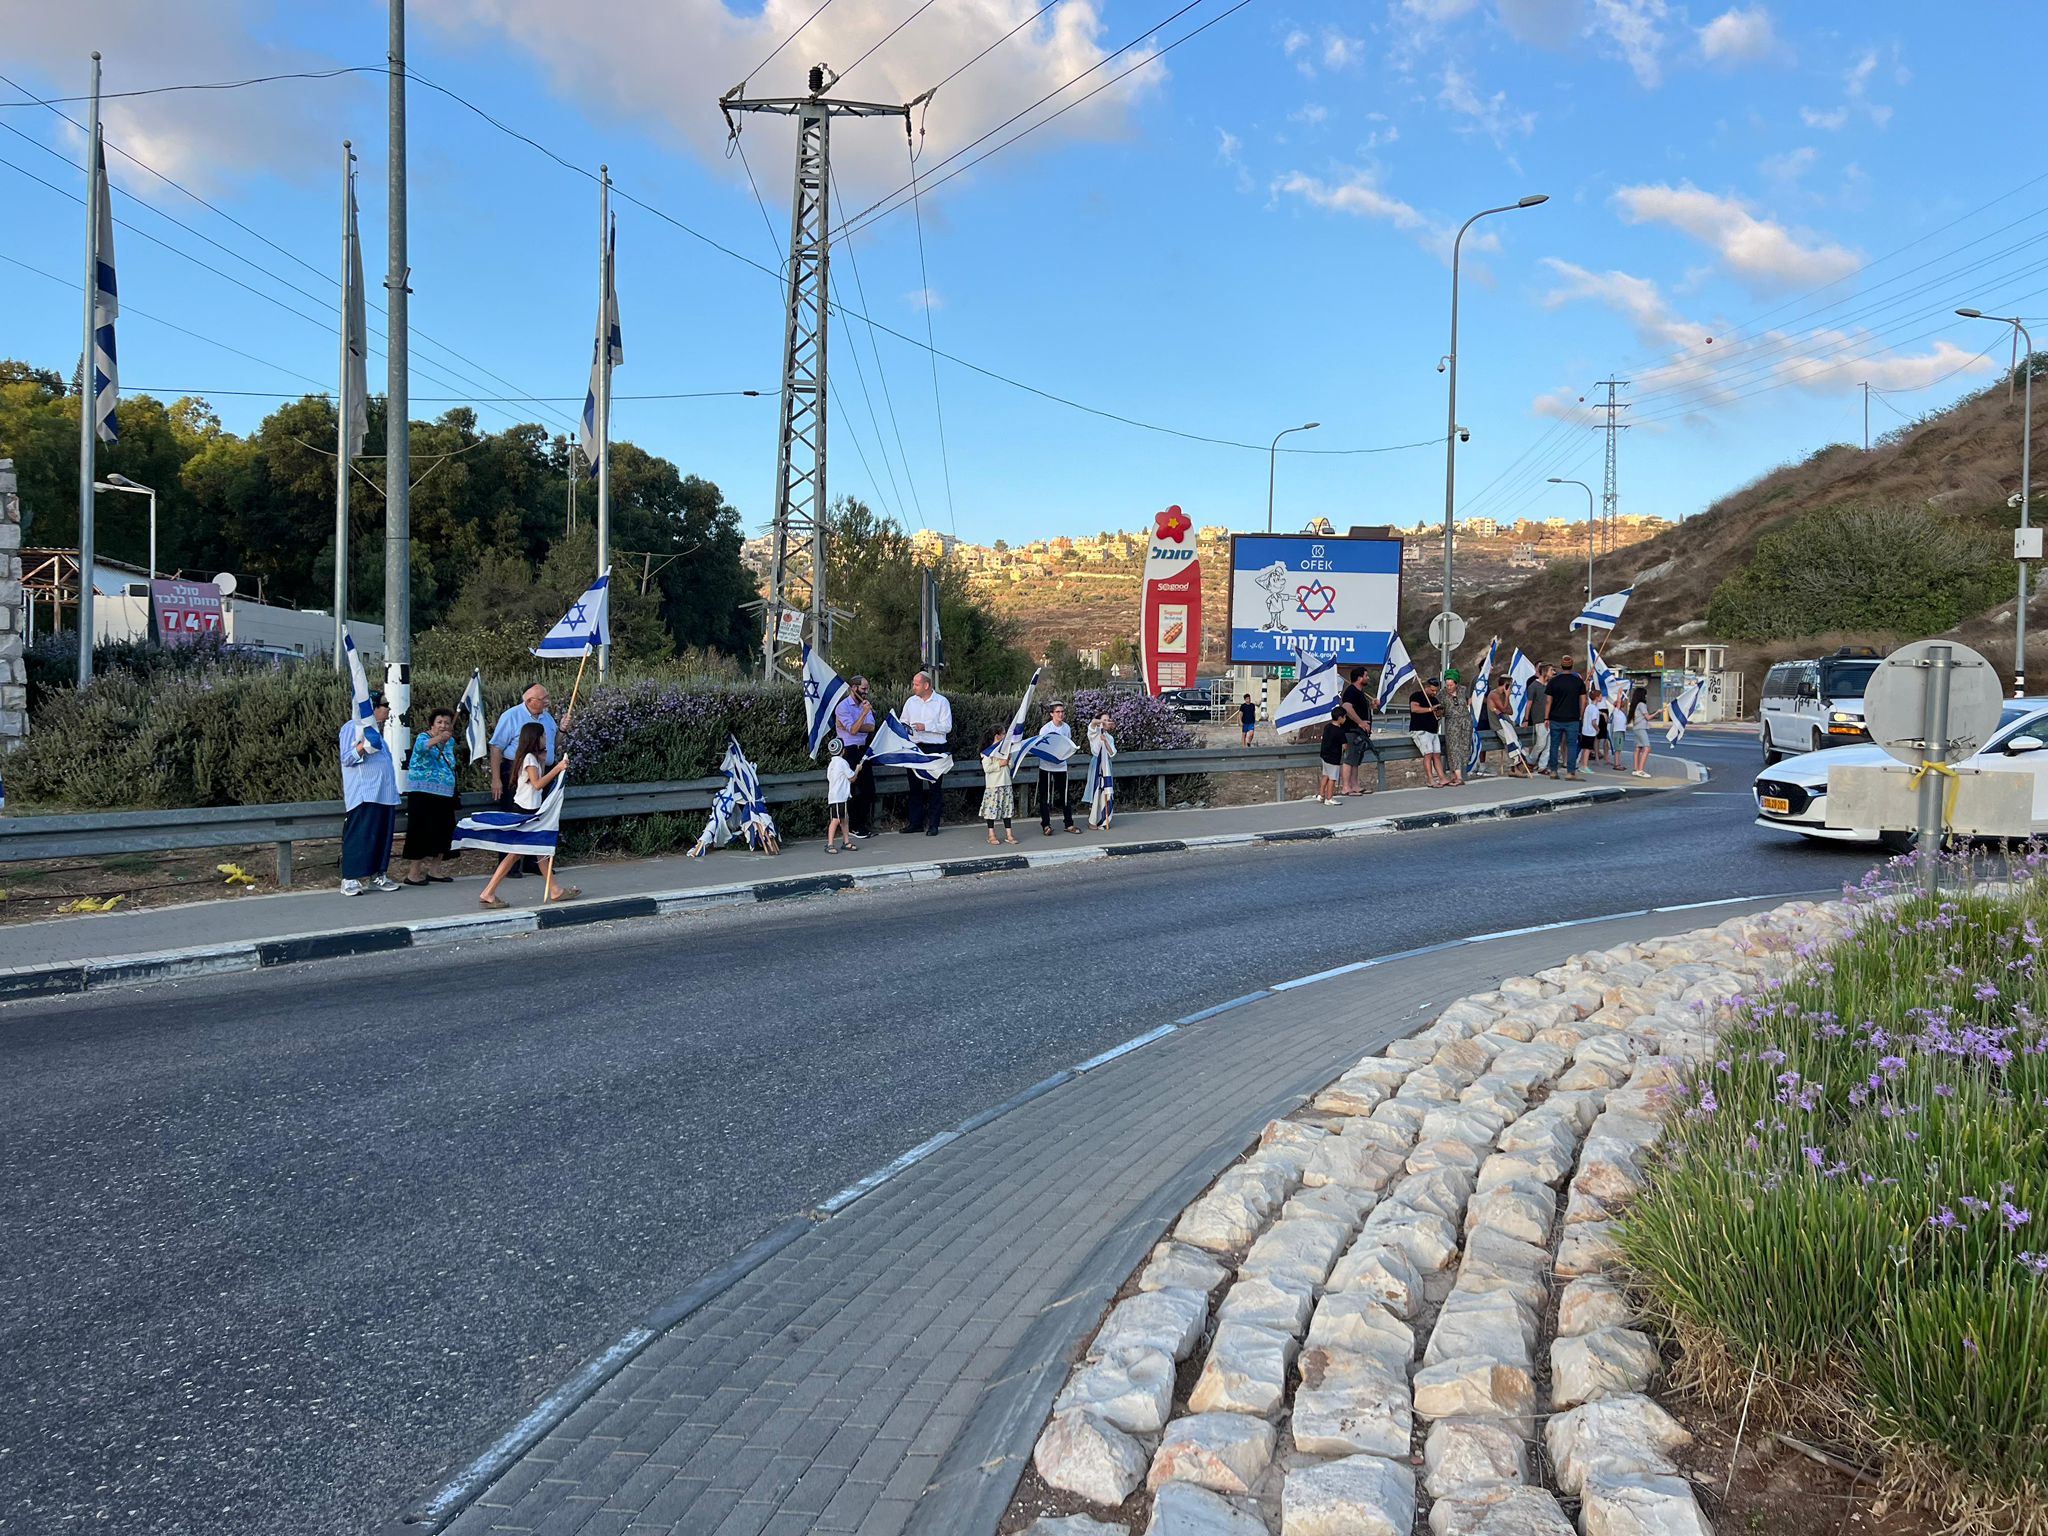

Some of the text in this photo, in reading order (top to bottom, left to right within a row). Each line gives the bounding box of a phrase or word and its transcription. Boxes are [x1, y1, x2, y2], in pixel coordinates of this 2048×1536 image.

[1151, 546, 1194, 560] סונול
[1300, 560, 1333, 570] OFEK
[173, 584, 199, 596] סולר
[155, 593, 219, 607] מזומן בלבד
[164, 611, 219, 631] 747
[1273, 633, 1318, 651] לתמיד
[1320, 636, 1355, 652] ביחד
